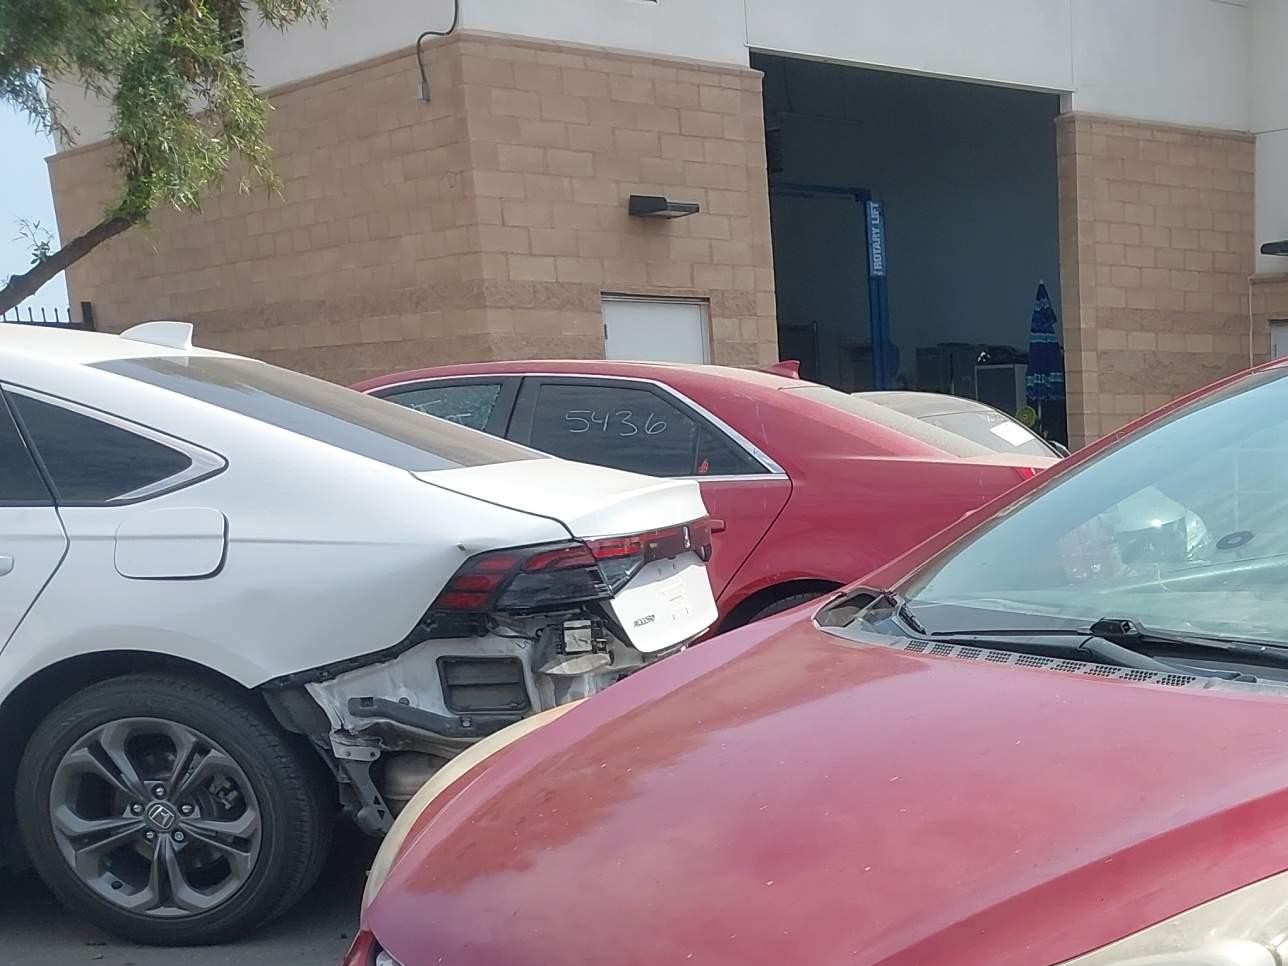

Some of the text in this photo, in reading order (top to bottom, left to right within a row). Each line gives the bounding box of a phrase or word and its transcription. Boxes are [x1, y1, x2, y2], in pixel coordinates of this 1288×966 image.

[871, 202, 882, 270] ROTARY LIFT
[565, 410, 667, 436] 5436
